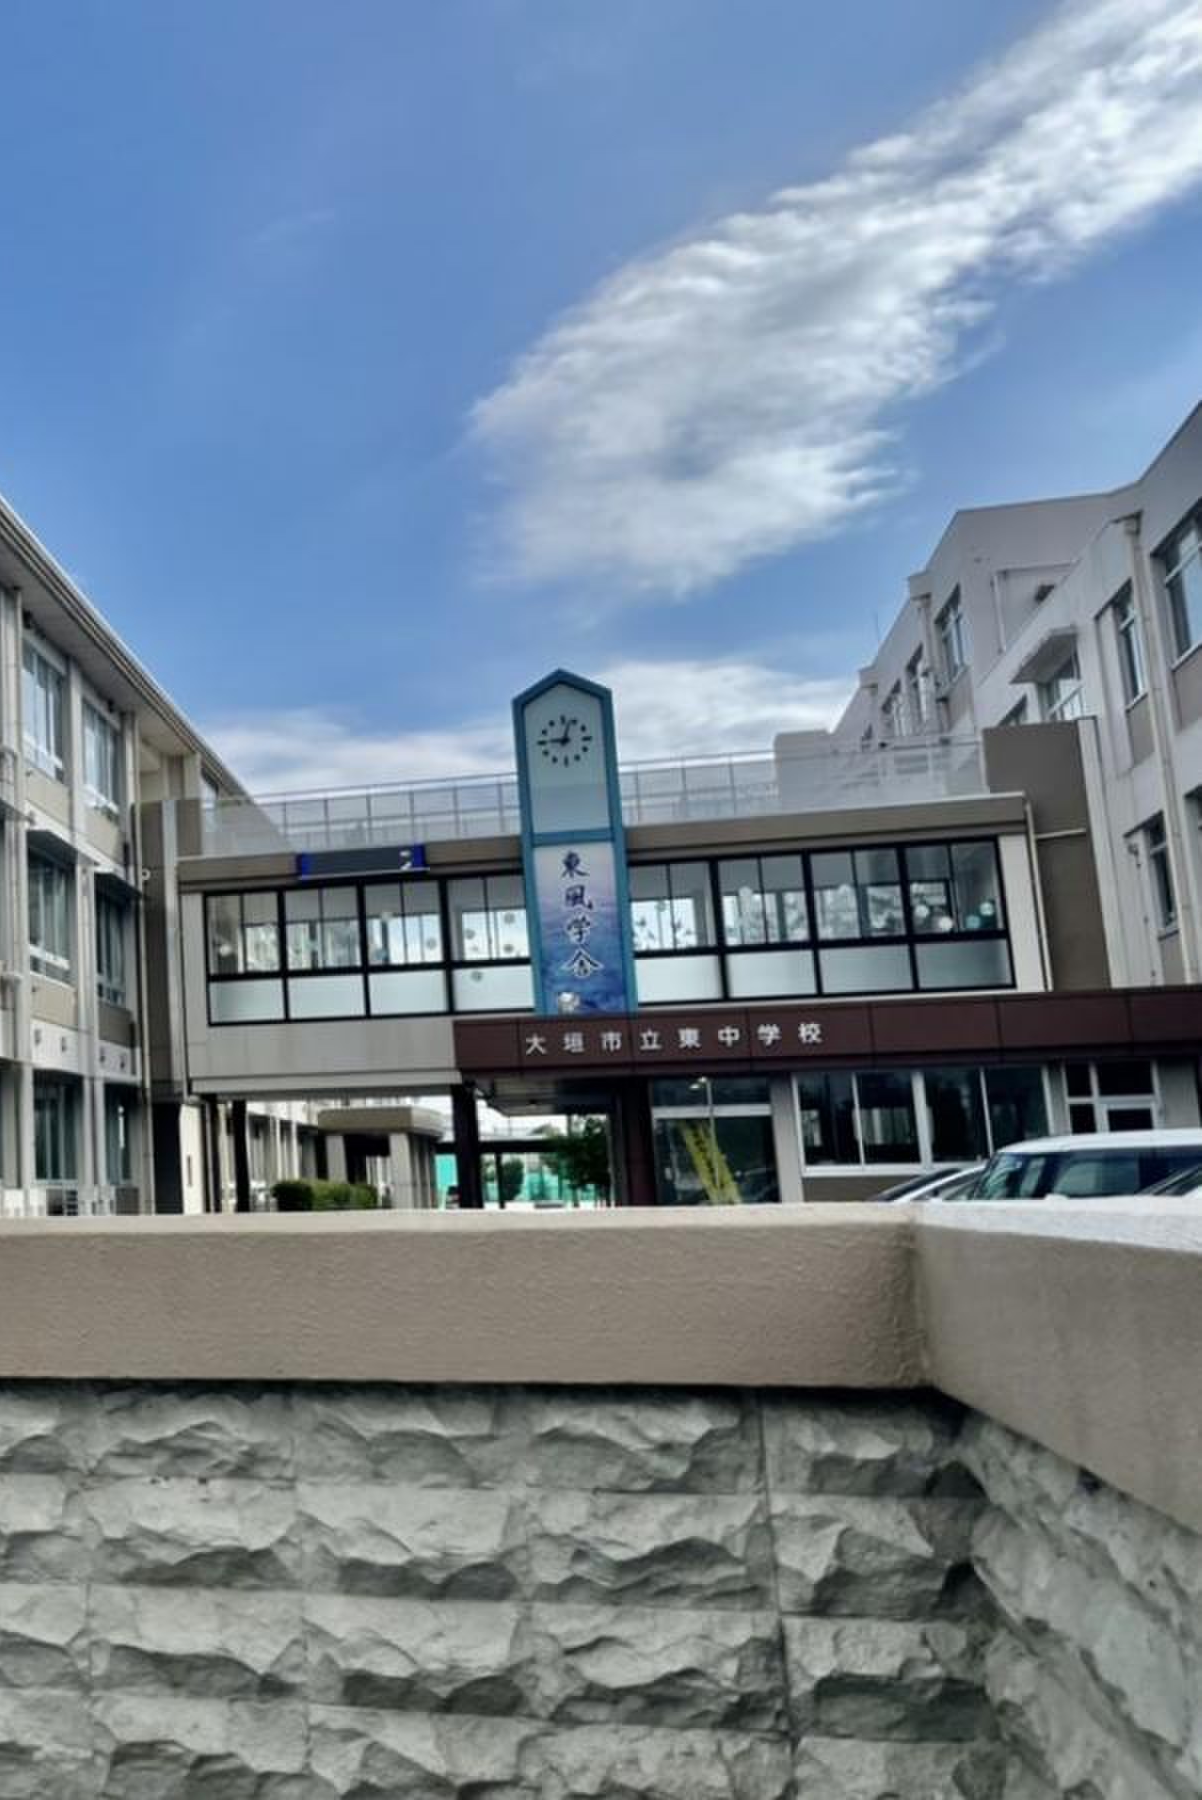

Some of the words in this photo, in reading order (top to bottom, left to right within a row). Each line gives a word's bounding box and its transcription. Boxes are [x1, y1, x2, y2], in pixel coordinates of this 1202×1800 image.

[525, 1022, 823, 1056] 大垣市立東中学校
